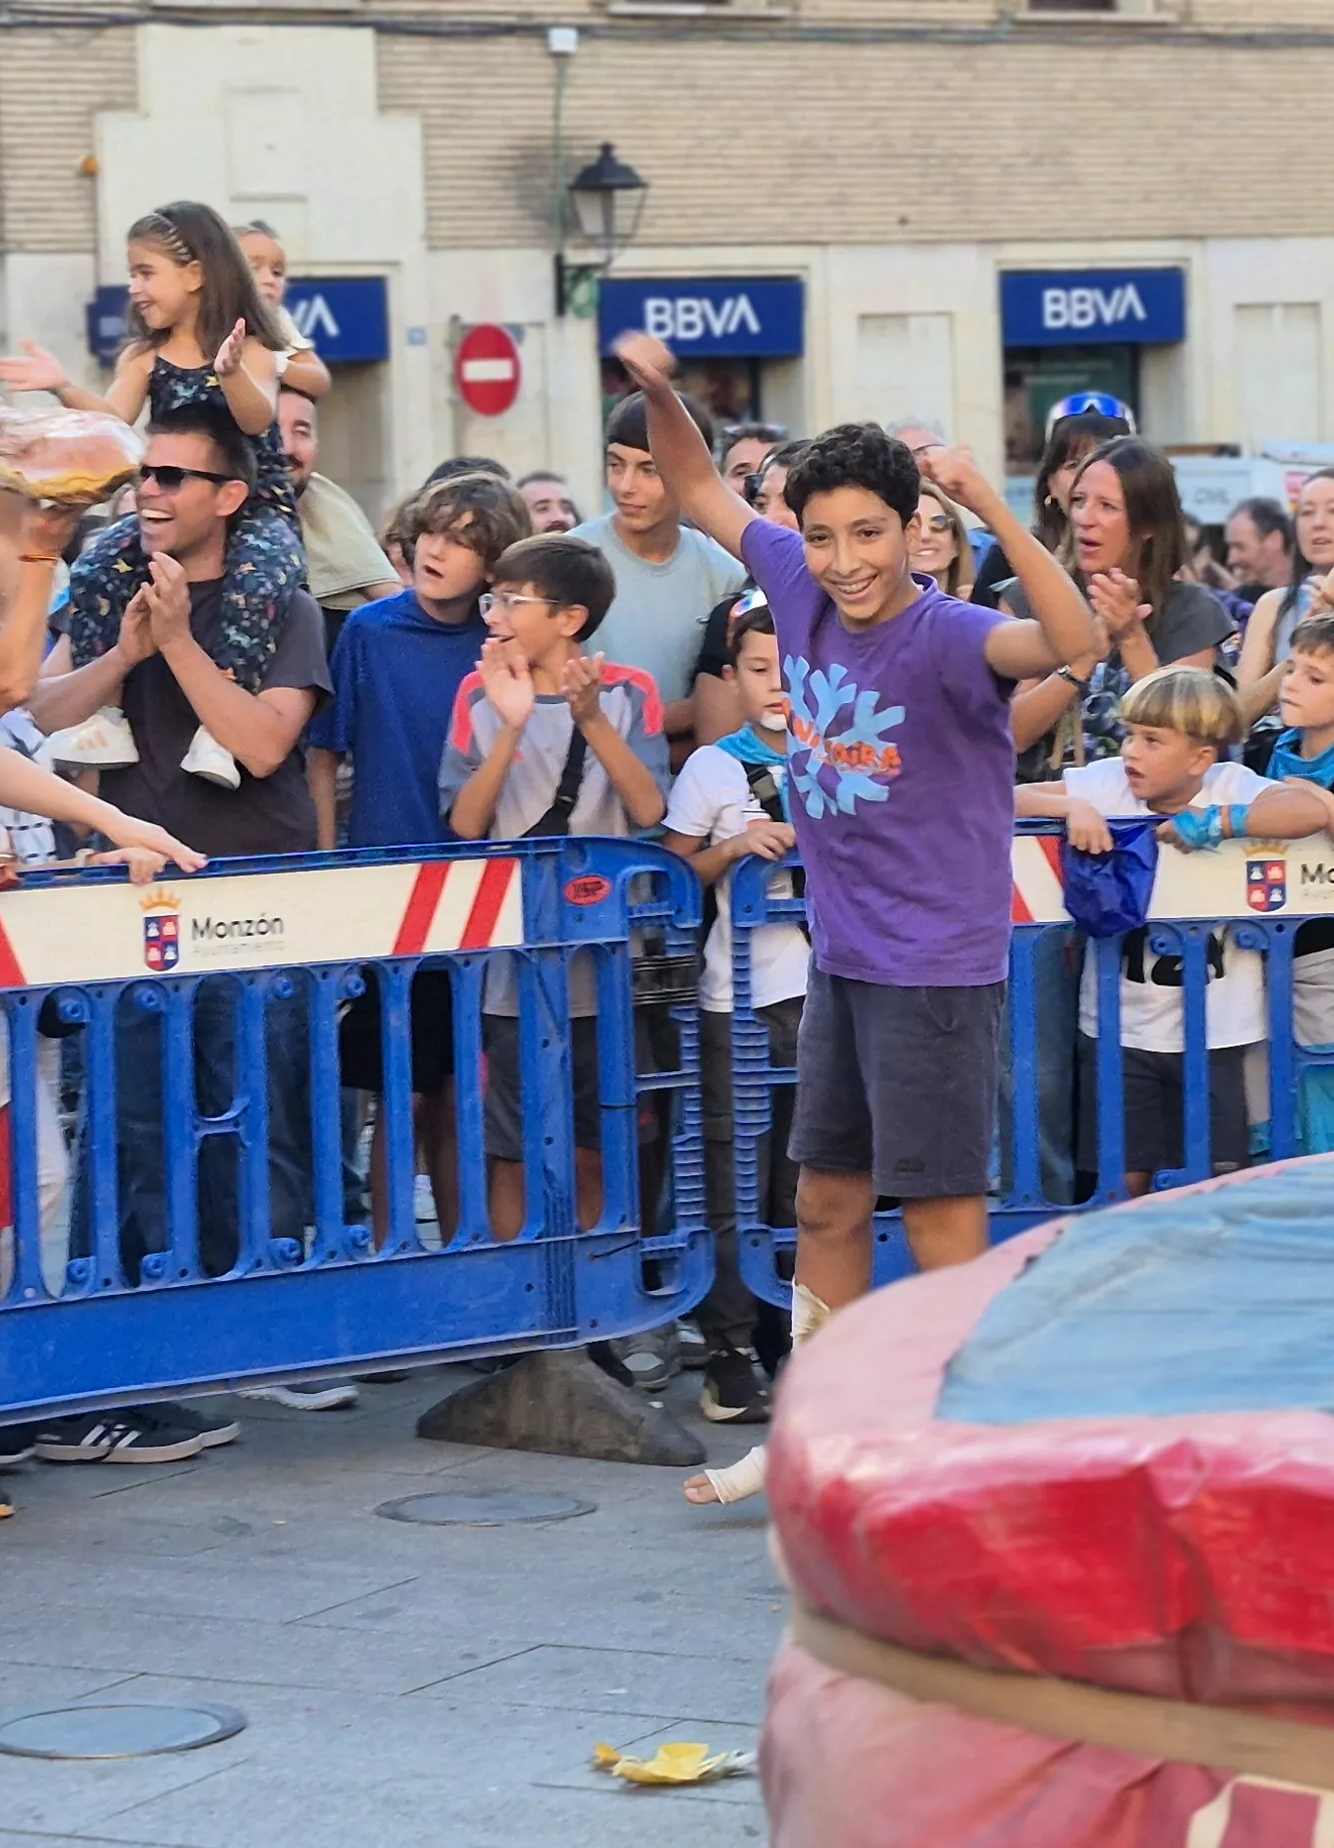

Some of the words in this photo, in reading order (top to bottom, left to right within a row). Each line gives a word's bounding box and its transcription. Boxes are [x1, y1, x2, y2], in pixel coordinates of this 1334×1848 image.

[644, 293, 762, 340] BBVA
[1043, 282, 1148, 329] BBVA
[191, 912, 285, 941] Monzón
